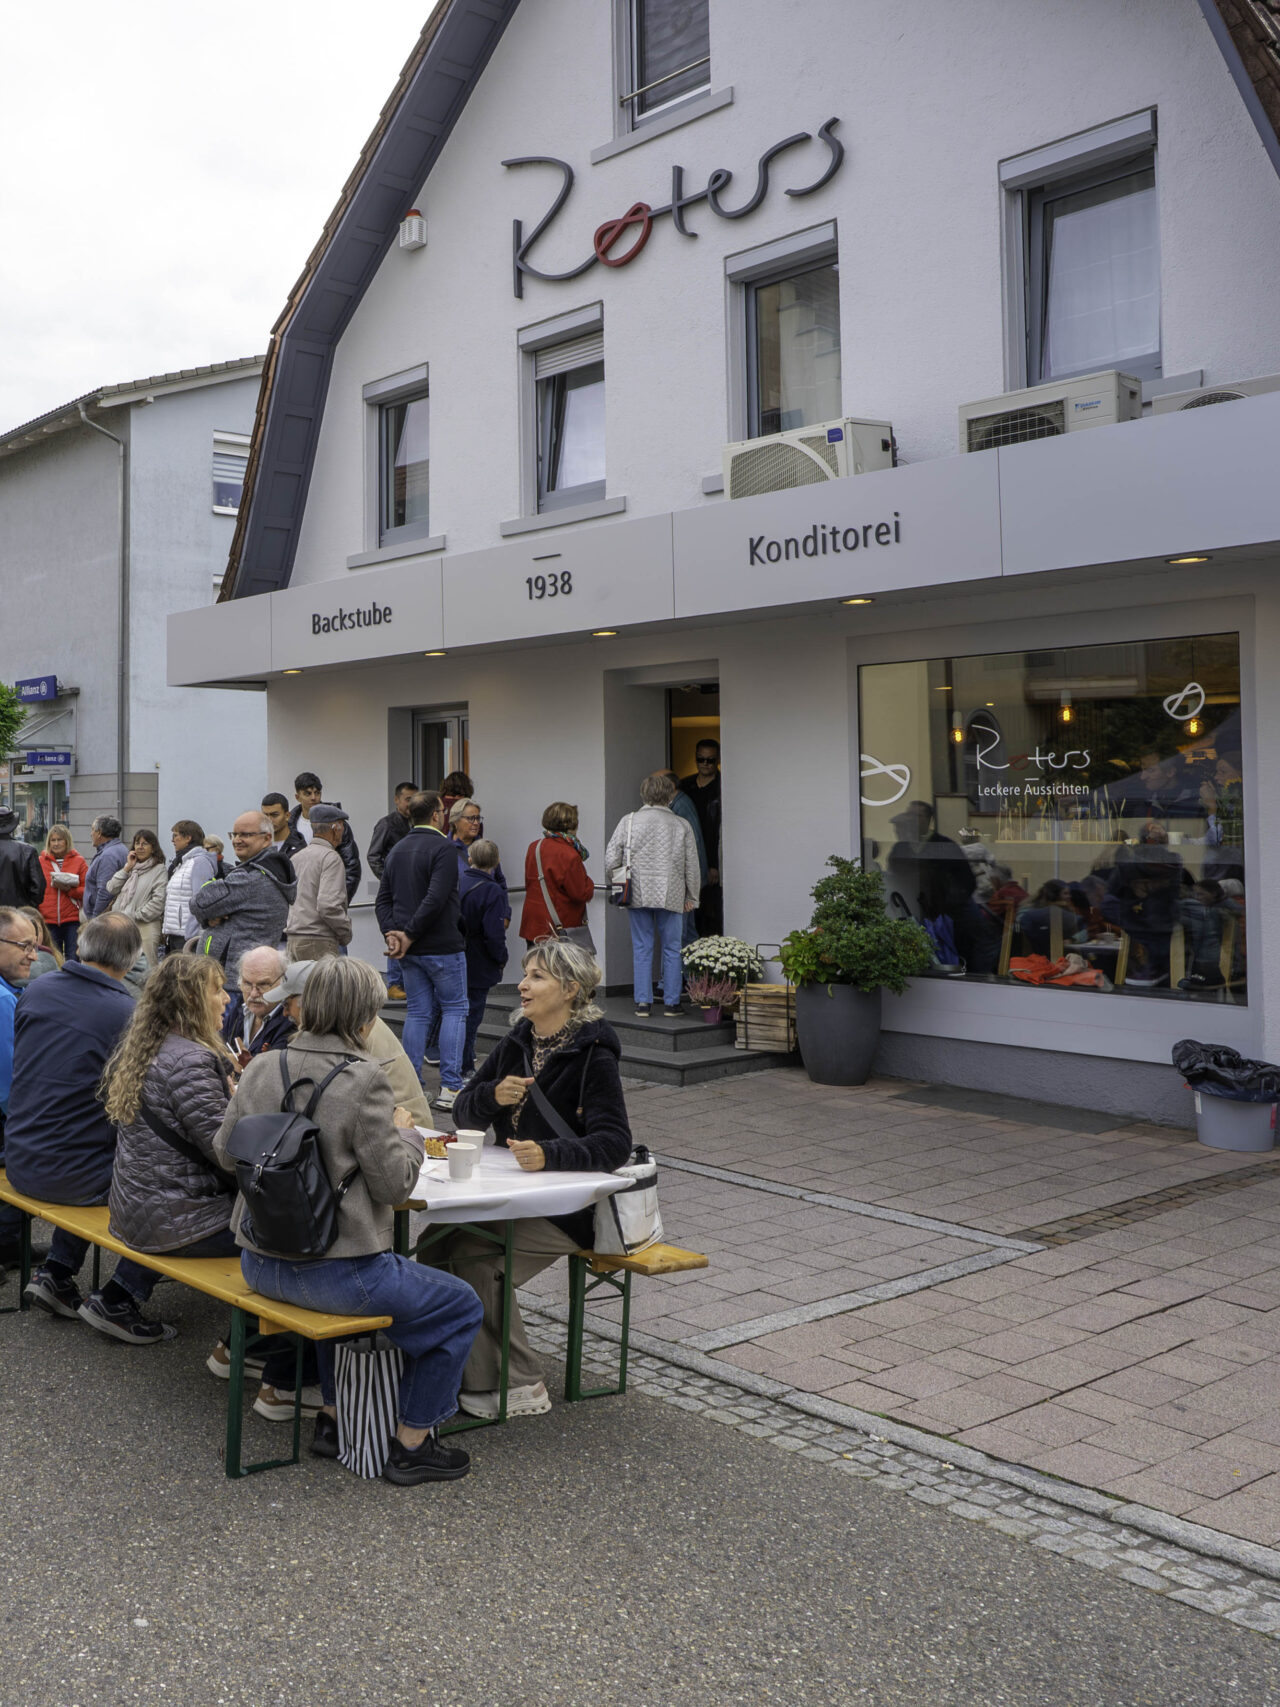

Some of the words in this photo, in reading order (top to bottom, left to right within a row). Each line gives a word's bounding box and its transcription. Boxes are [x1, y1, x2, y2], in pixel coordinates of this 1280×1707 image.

[501, 117, 844, 299] Roters
[749, 512, 901, 565] Konditorei
[526, 571, 573, 600] 1938
[312, 602, 393, 634] Backstube
[22, 685, 40, 696] Allianz
[971, 725, 1091, 771] Roters
[978, 783, 1020, 796] Leckere
[1024, 783, 1089, 796] Aussichten
